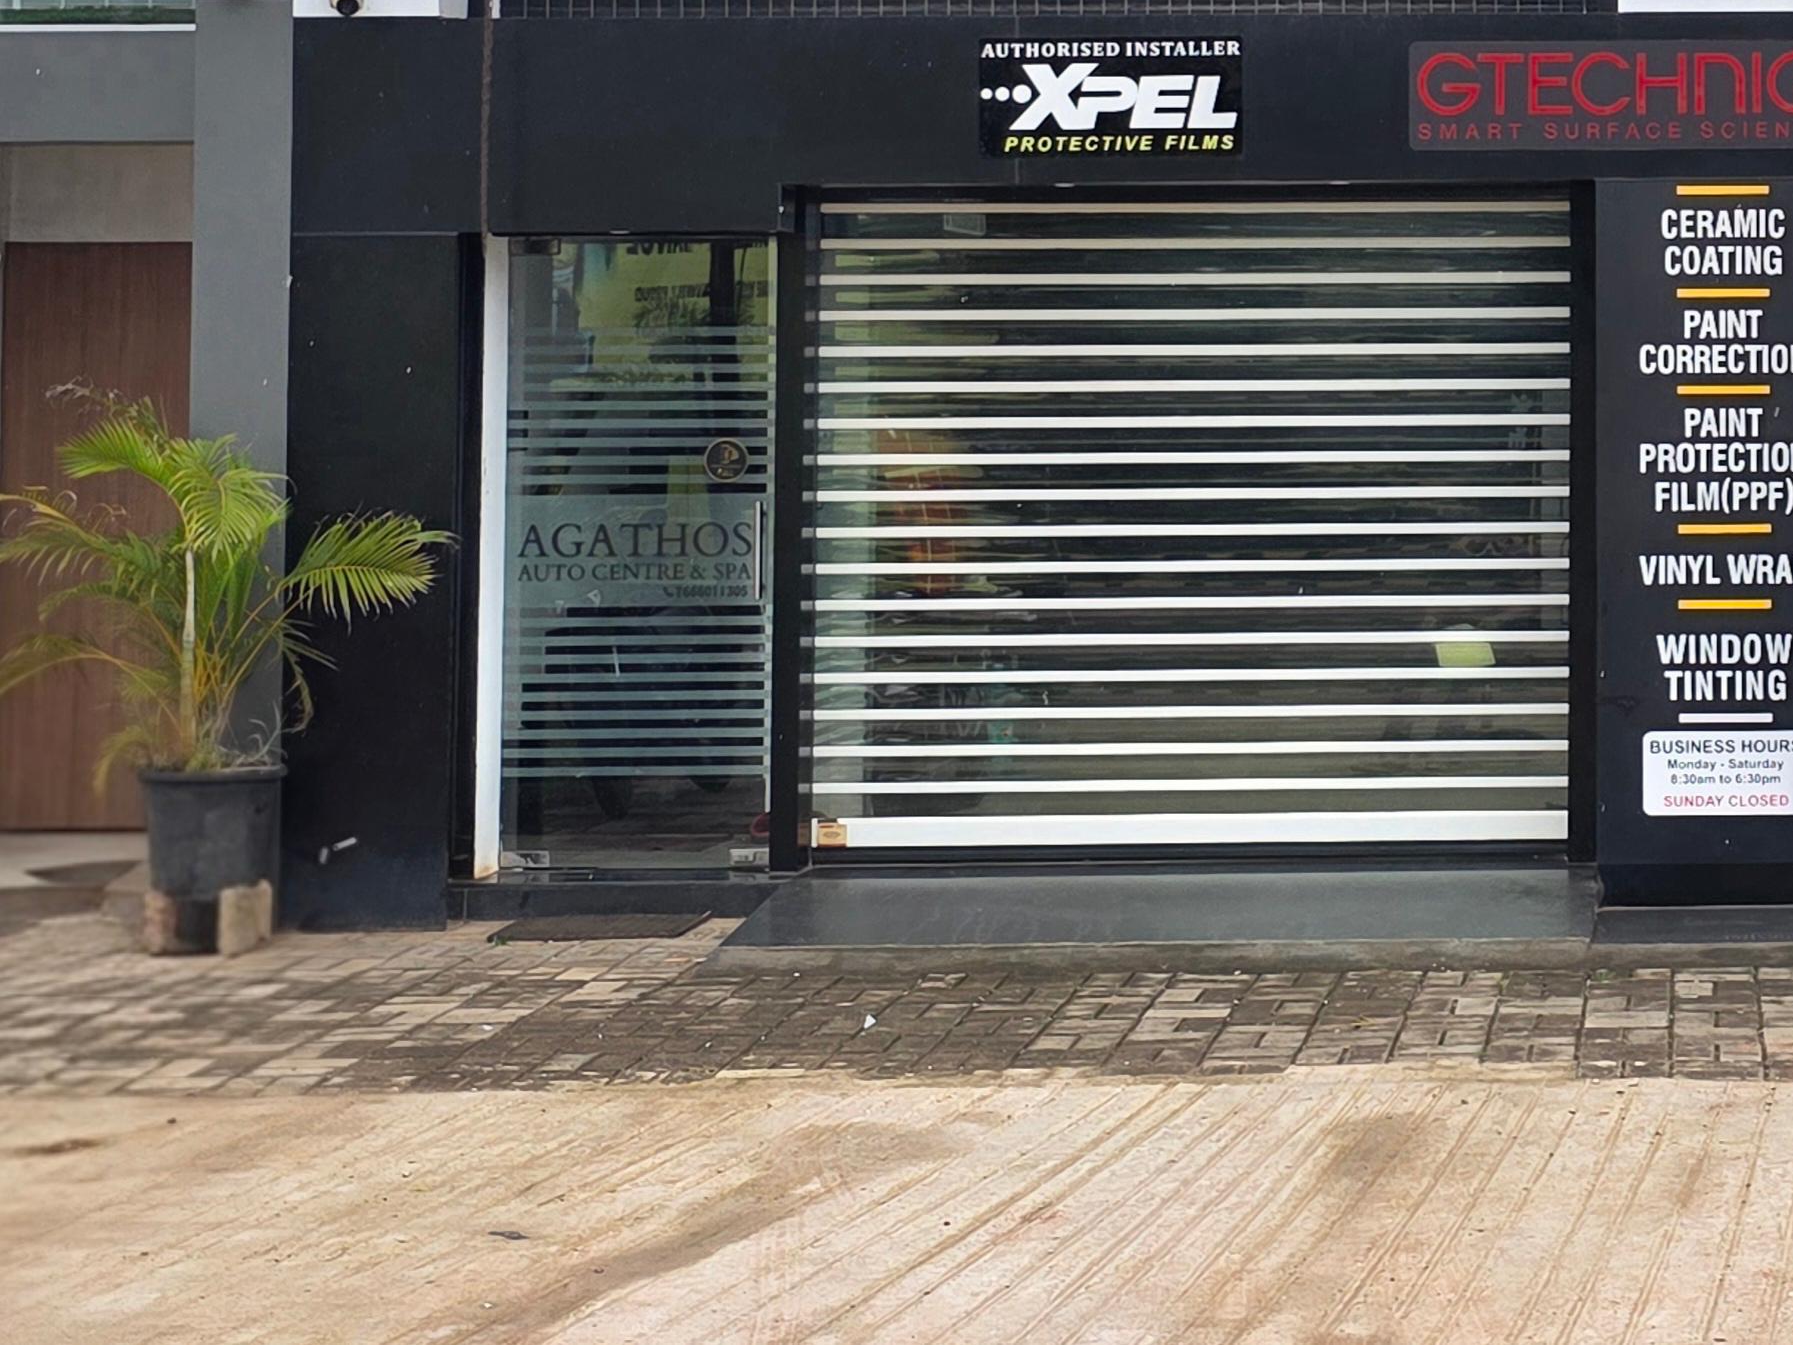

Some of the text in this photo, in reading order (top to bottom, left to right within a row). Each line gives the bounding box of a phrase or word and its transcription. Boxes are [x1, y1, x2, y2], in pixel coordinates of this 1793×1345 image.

[980, 40, 1241, 59] AUTHORISED INSTALLER
[1008, 62, 1238, 131] XPEL
[1004, 134, 1235, 153] PROTECTIVE FILMS
[1417, 123, 1523, 141] SMART
[1542, 122, 1682, 139] SURFACE
[1661, 208, 1785, 240] CERAMIC
[1664, 245, 1783, 276] COATING
[1683, 309, 1763, 340] PAINT
[1684, 407, 1763, 438] PAINT
[518, 522, 754, 558] AGATHOS
[518, 562, 751, 582] AUTO CENTRE & SPA
[1638, 554, 1721, 586] VINYL
[1655, 633, 1793, 665] WINDOW
[1663, 669, 1787, 701] TINTING
[1650, 739, 1736, 754] BUSINESS
[1667, 759, 1716, 772] Monday
[1728, 758, 1784, 771] Saturday
[1670, 773, 1781, 785] 8:30am to 6:30pm
[1663, 794, 1790, 808] SUNDAY CLOSED
